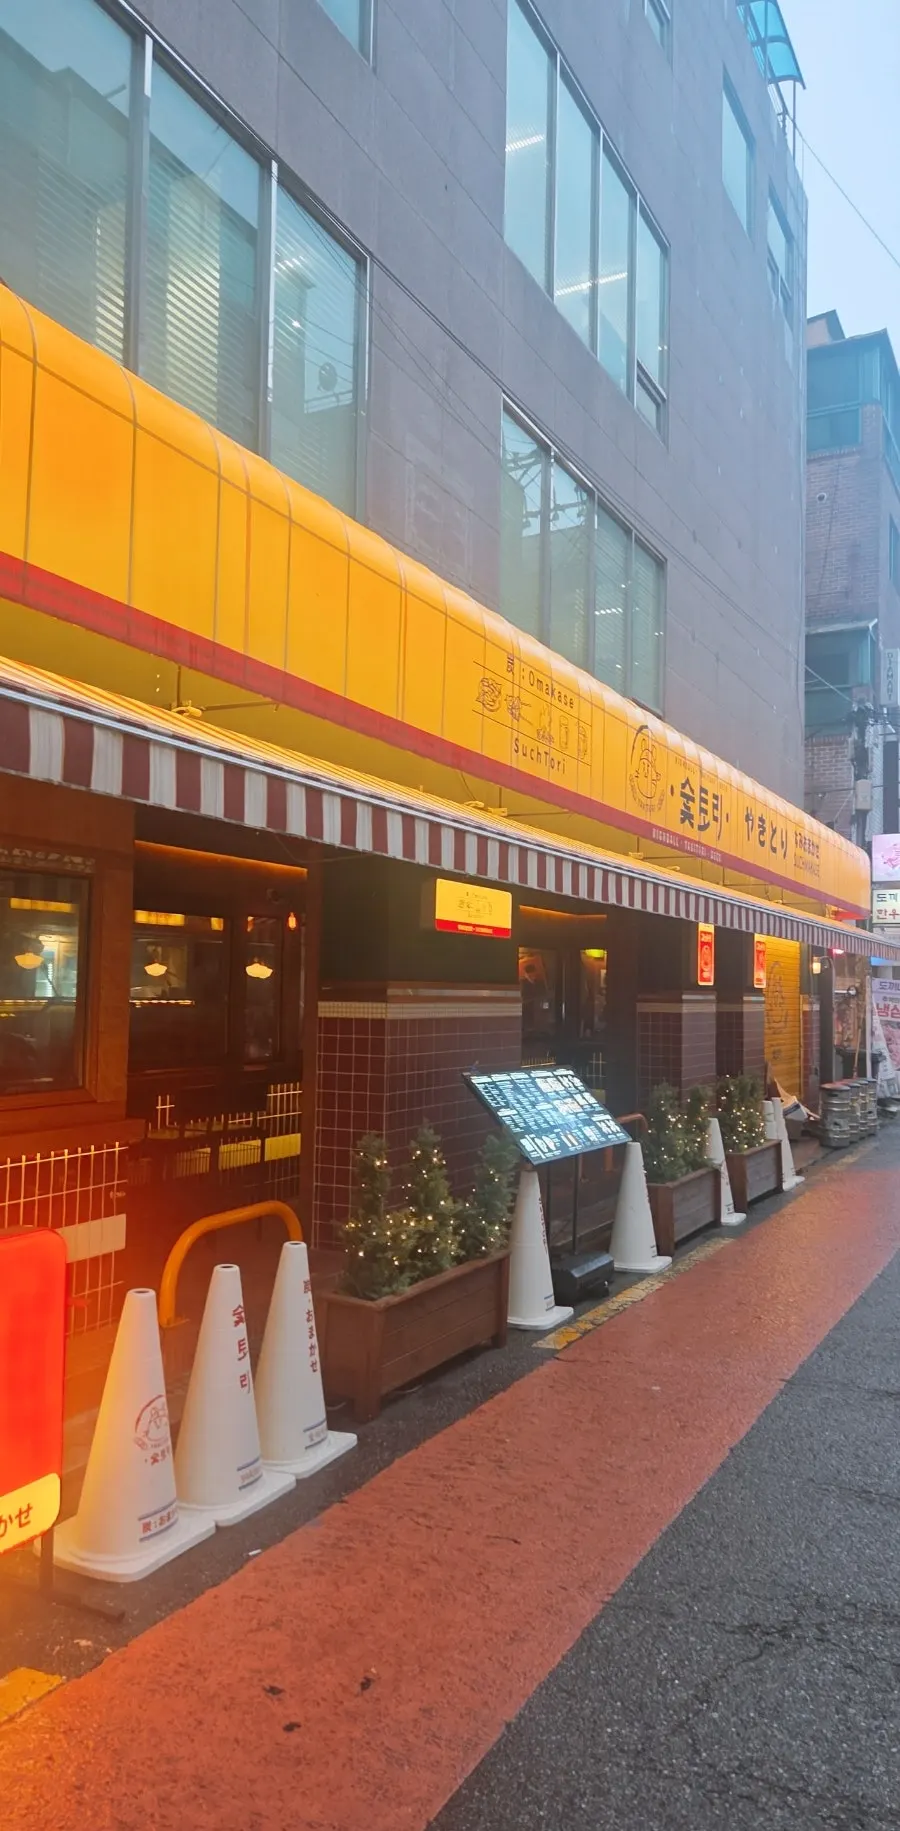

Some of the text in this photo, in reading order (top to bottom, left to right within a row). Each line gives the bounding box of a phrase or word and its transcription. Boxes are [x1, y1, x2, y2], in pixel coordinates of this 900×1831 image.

[513, 737, 566, 775] SuchTori
[744, 806, 788, 860] やきとり
